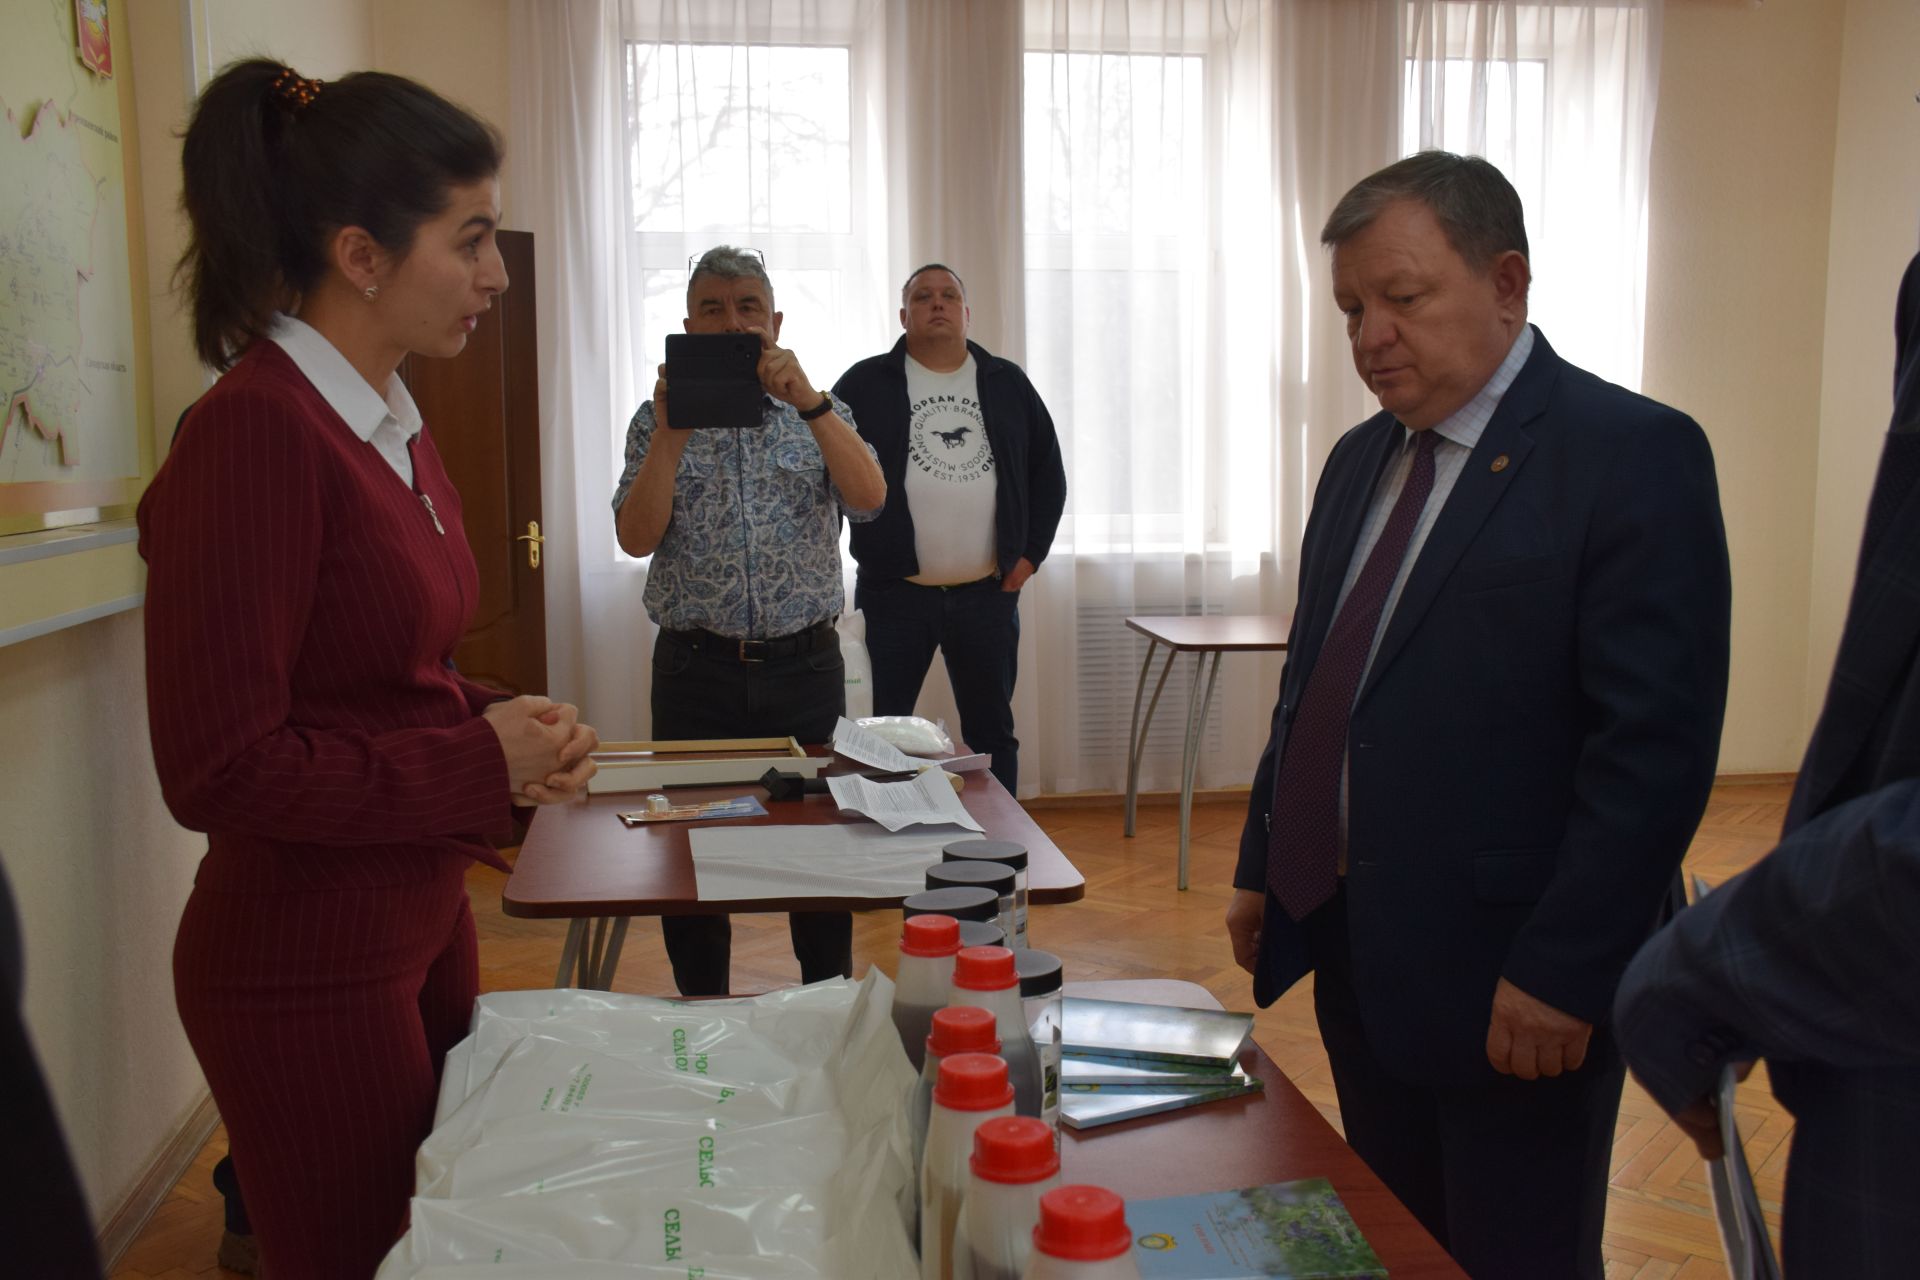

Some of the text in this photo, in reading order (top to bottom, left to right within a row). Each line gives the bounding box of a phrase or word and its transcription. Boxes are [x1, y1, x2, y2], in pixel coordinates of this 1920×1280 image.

[914, 405, 948, 430] QUALITY
[908, 440, 931, 472] FIRS
[915, 434, 956, 471] MUSTANG
[961, 444, 988, 471] GOODS
